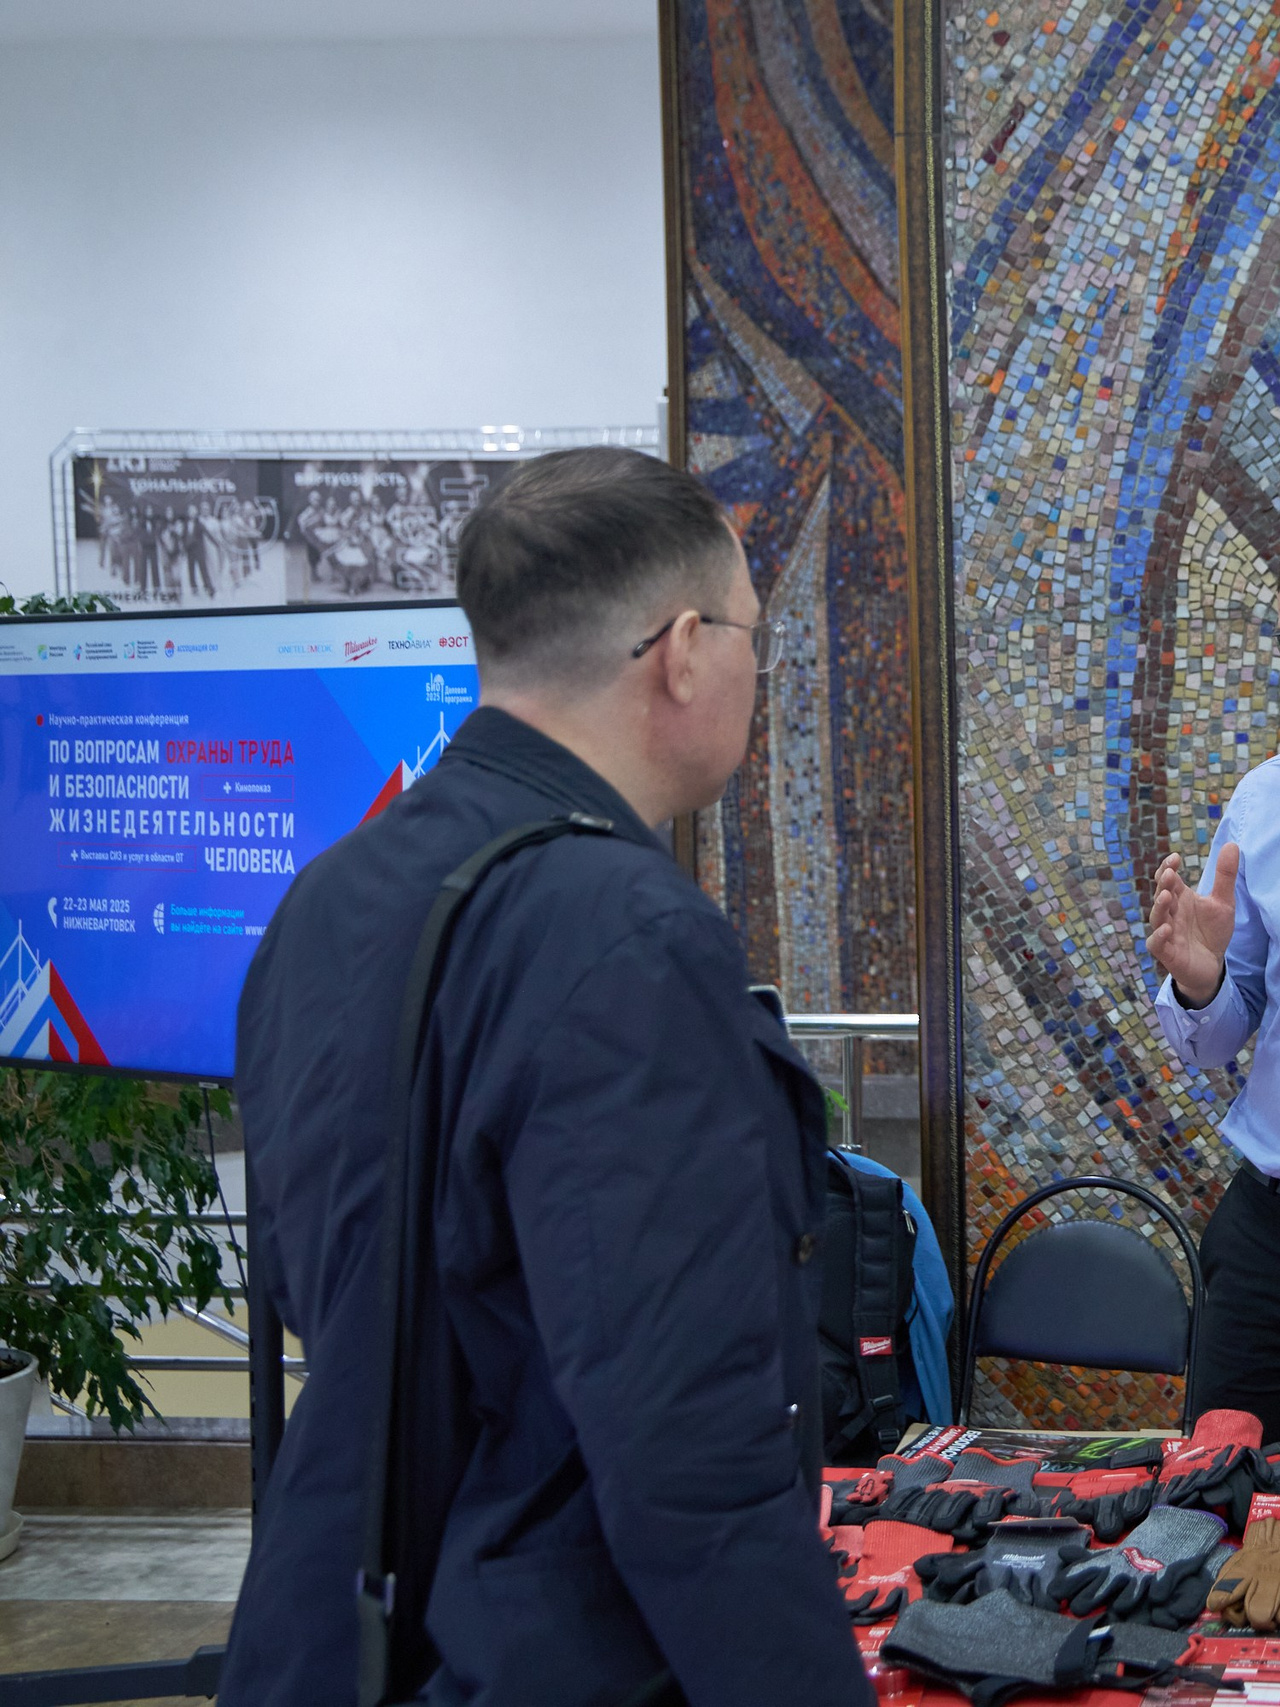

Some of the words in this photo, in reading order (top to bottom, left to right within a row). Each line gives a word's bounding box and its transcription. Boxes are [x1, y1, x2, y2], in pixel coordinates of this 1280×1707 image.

[49, 713, 133, 728] Научно-практическая
[135, 713, 189, 726] конференция
[49, 739, 70, 764] ПО
[75, 739, 160, 765] ВОПРОСАМ
[166, 740, 233, 765] ОХРАНЫ
[239, 740, 295, 768] ТРУДА
[49, 774, 60, 798] И
[65, 774, 190, 799] БЕЗОПАСНОСТИ
[235, 782, 272, 793] Кинопоказ
[49, 808, 295, 839] ЖИЗНЕДЕЯТЕЛЬНОСТИ
[205, 847, 296, 875] ЧЕЛОВЕКА
[63, 897, 88, 912] 22-23
[89, 898, 108, 912] МАЯ
[109, 899, 130, 913] 2025
[63, 916, 136, 933] НИЖНЕВАРТОВСК
